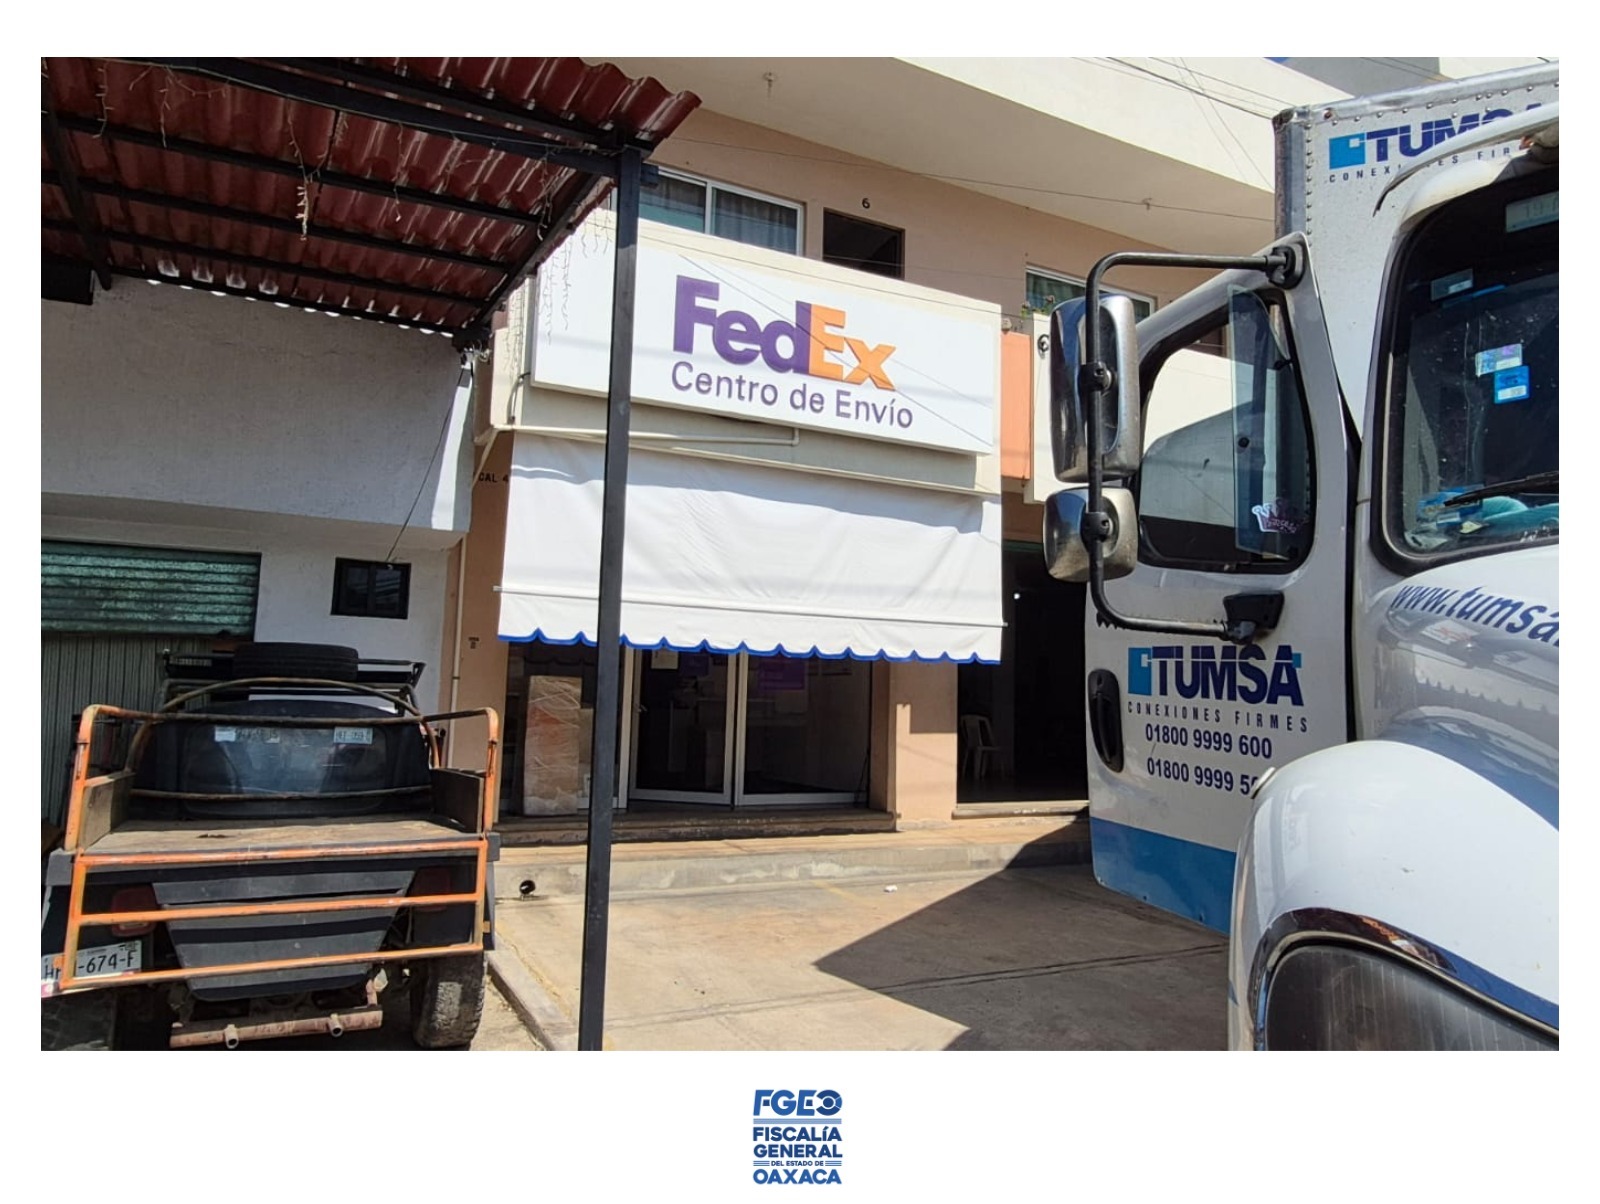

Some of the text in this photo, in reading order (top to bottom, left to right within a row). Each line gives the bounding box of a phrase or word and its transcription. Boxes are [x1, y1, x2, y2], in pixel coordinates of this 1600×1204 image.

[862, 197, 870, 209] 6
[673, 274, 897, 391] FedEx
[671, 361, 914, 429] Centro de Envío
[1390, 585, 1559, 648] www.tumsa
[1152, 645, 1304, 706] TUMSA
[1128, 701, 1307, 733] CONEXIONES FIRMES
[1145, 723, 1272, 759] 01800 9999 600
[1147, 757, 1190, 783] 01800
[1194, 765, 1234, 792] 9999
